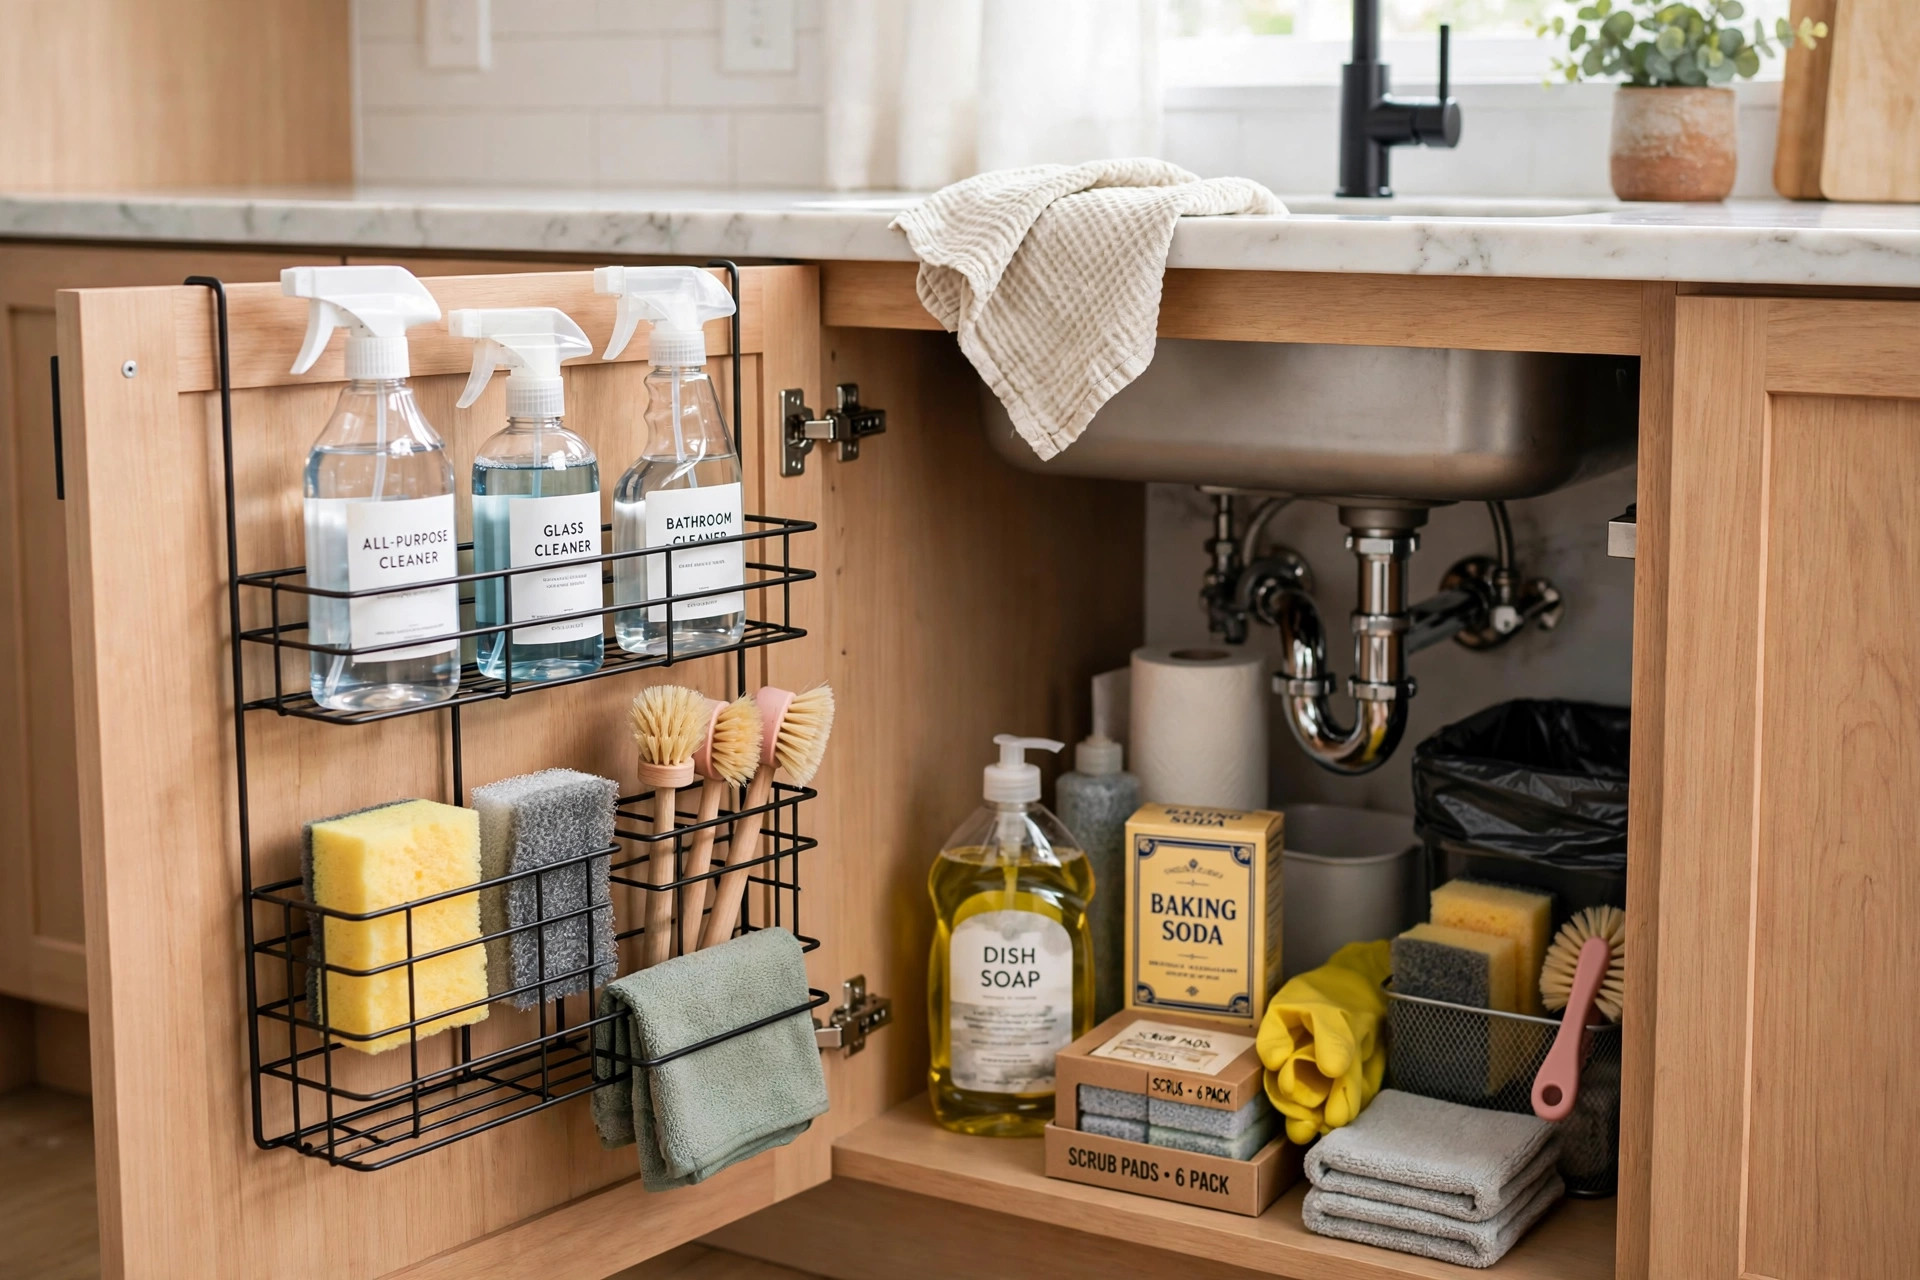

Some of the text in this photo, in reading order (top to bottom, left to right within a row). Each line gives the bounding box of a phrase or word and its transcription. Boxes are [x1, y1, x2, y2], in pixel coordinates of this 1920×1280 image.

[543, 521, 584, 537] GLASS
[666, 511, 732, 530] BATHROOM
[362, 529, 448, 551] ALL-PURPOSE
[534, 539, 592, 557] CLEANER
[379, 551, 439, 569] CLEANER
[1169, 815, 1225, 828] SODA
[1150, 892, 1237, 921] BAKING
[1162, 920, 1224, 946] SODA
[983, 946, 1036, 965] DISH
[980, 969, 1041, 989] SOAP
[1196, 1085, 1203, 1100] 6
[1205, 1086, 1232, 1104] PACK
[1068, 1147, 1117, 1174] SCRUB
[1121, 1157, 1160, 1182] PADS
[1175, 1167, 1185, 1187] 6
[1190, 1170, 1230, 1196] PACK
